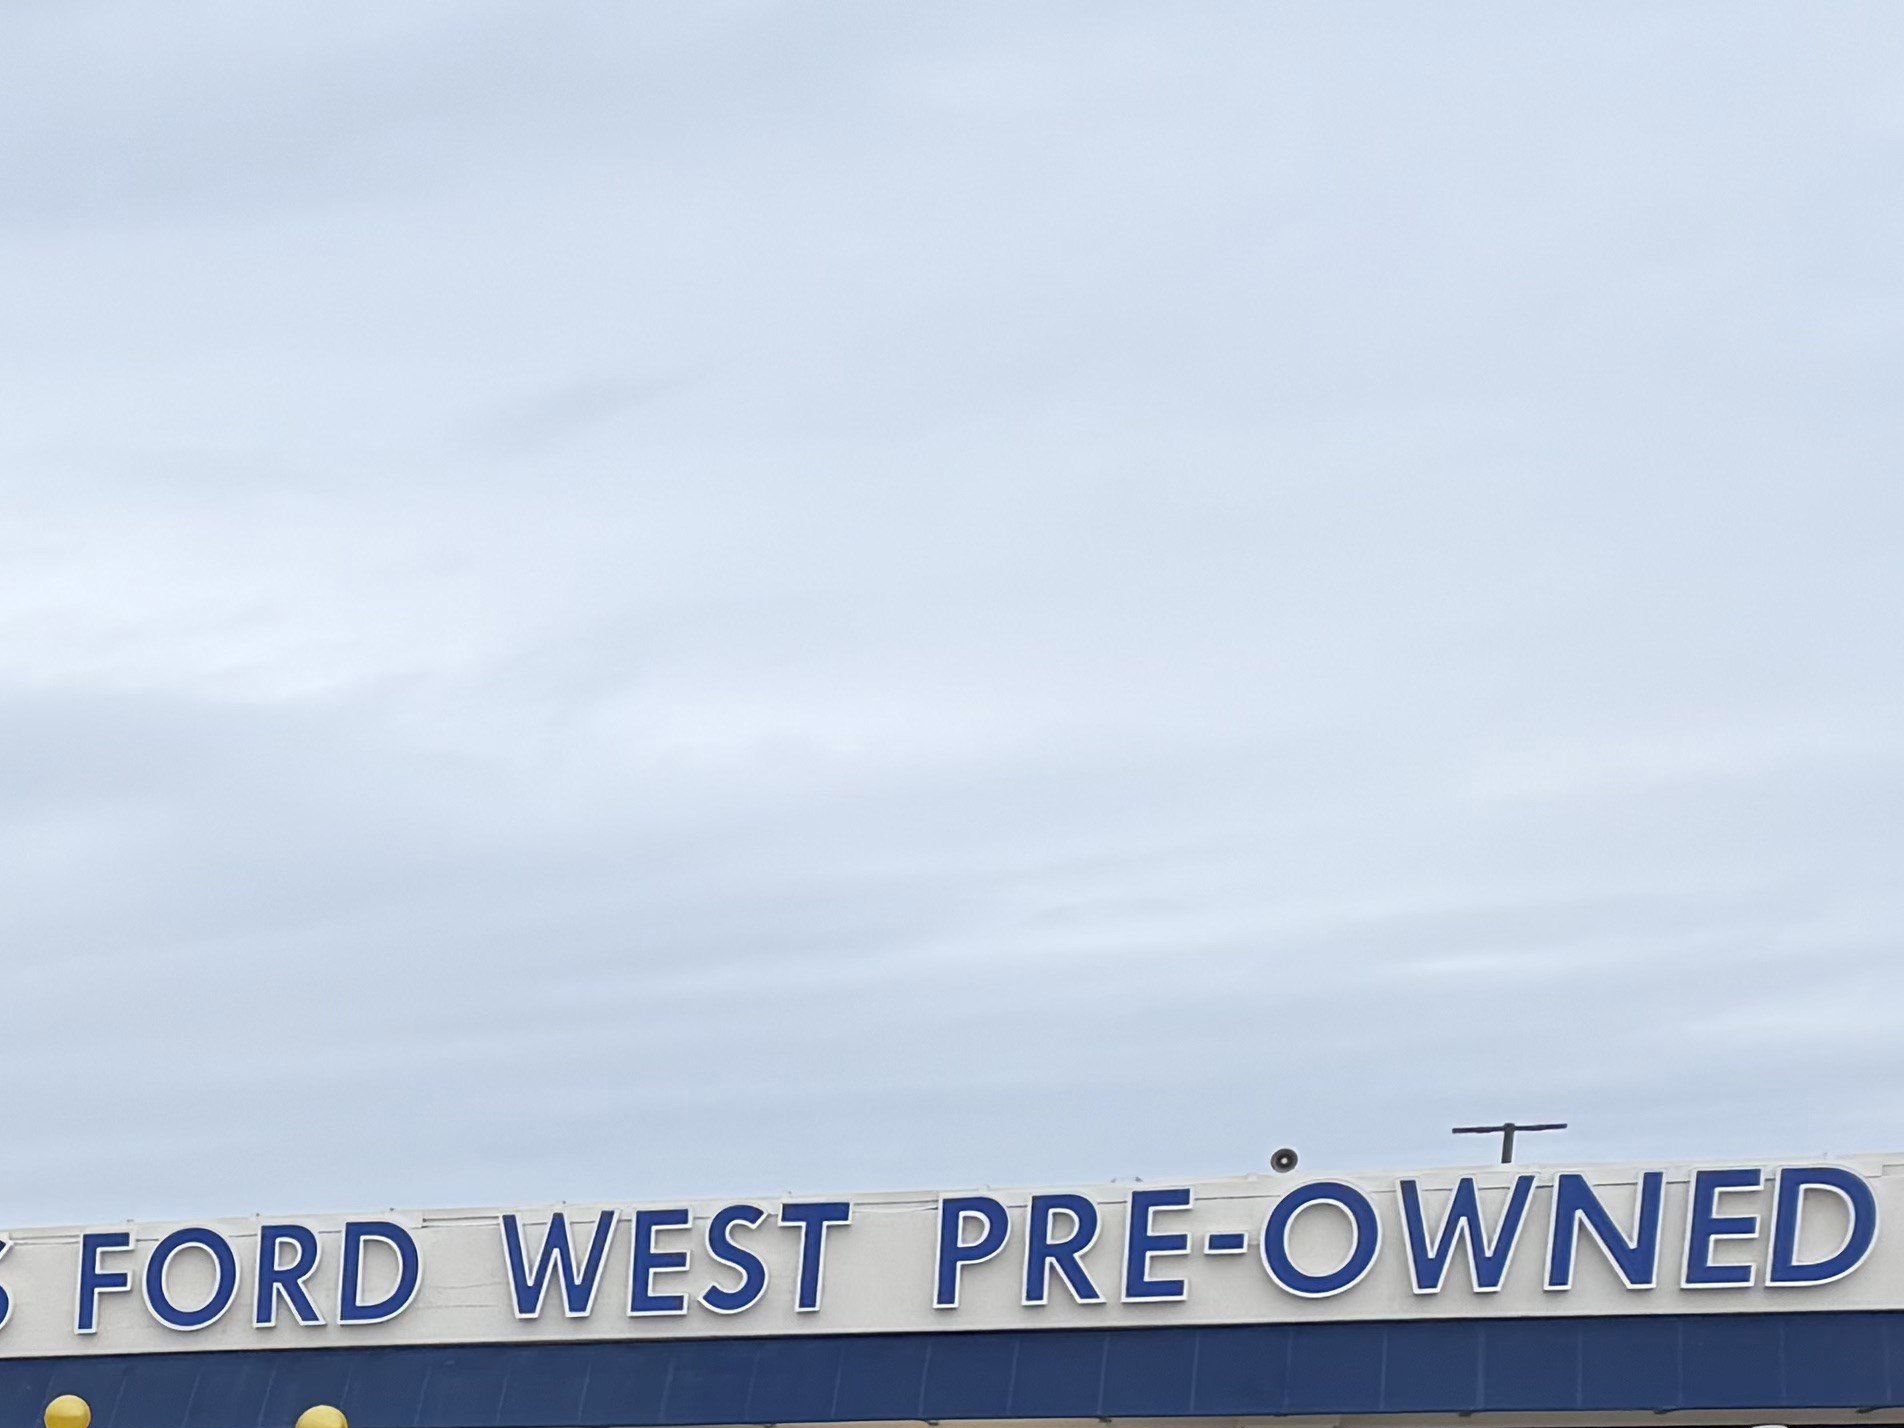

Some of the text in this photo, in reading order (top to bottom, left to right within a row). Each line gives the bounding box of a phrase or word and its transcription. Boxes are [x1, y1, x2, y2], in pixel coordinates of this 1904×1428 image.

[76, 1219, 422, 1332] FORD
[501, 1199, 853, 1317] WEST
[935, 1165, 1877, 1307] PRE-OWNED
